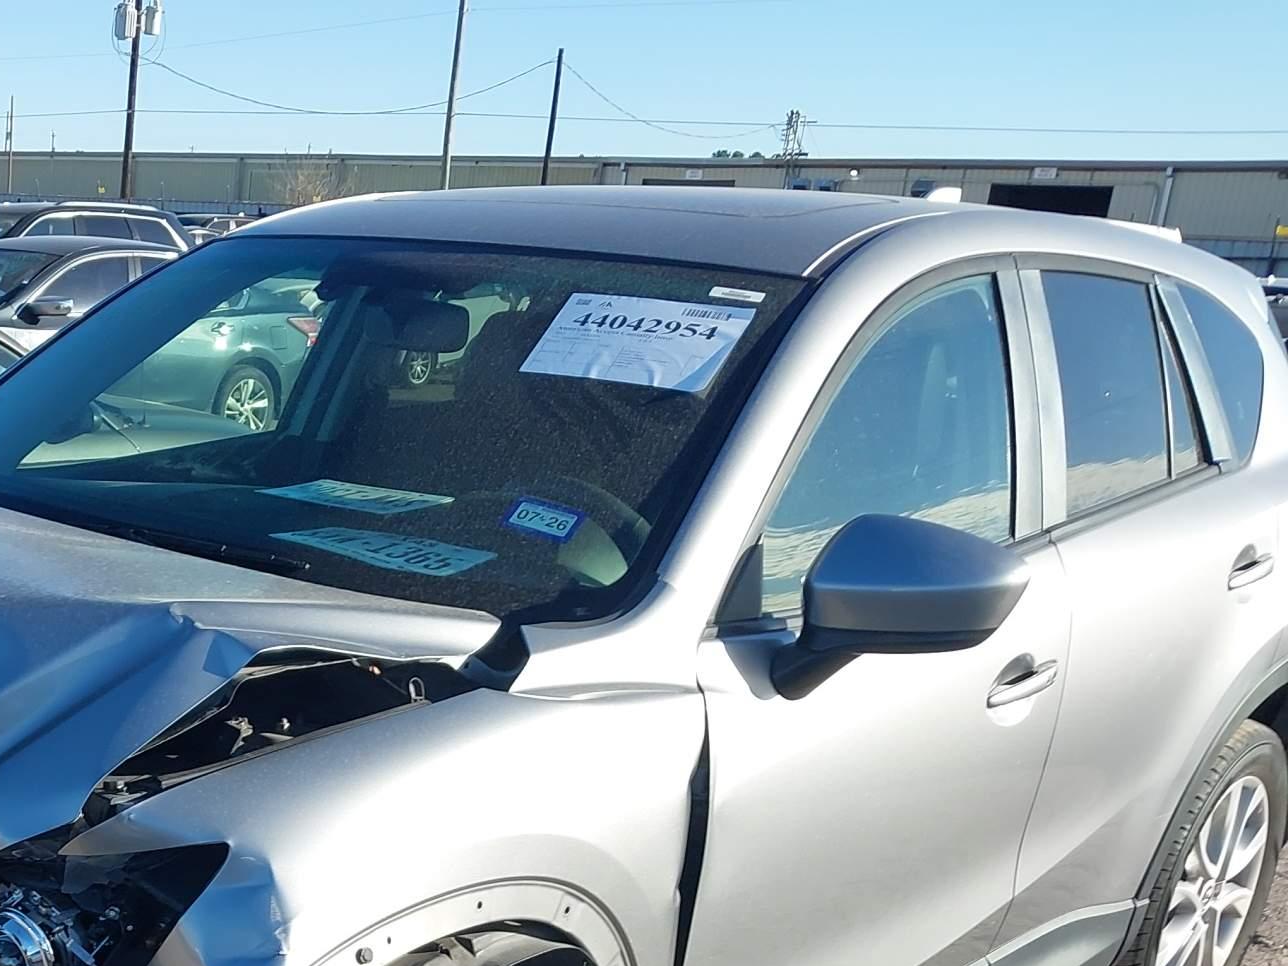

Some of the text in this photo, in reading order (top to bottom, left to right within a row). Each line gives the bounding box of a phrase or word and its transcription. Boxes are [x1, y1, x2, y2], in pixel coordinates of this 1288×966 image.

[573, 311, 719, 341] 44042954
[516, 508, 569, 531] 07 26
